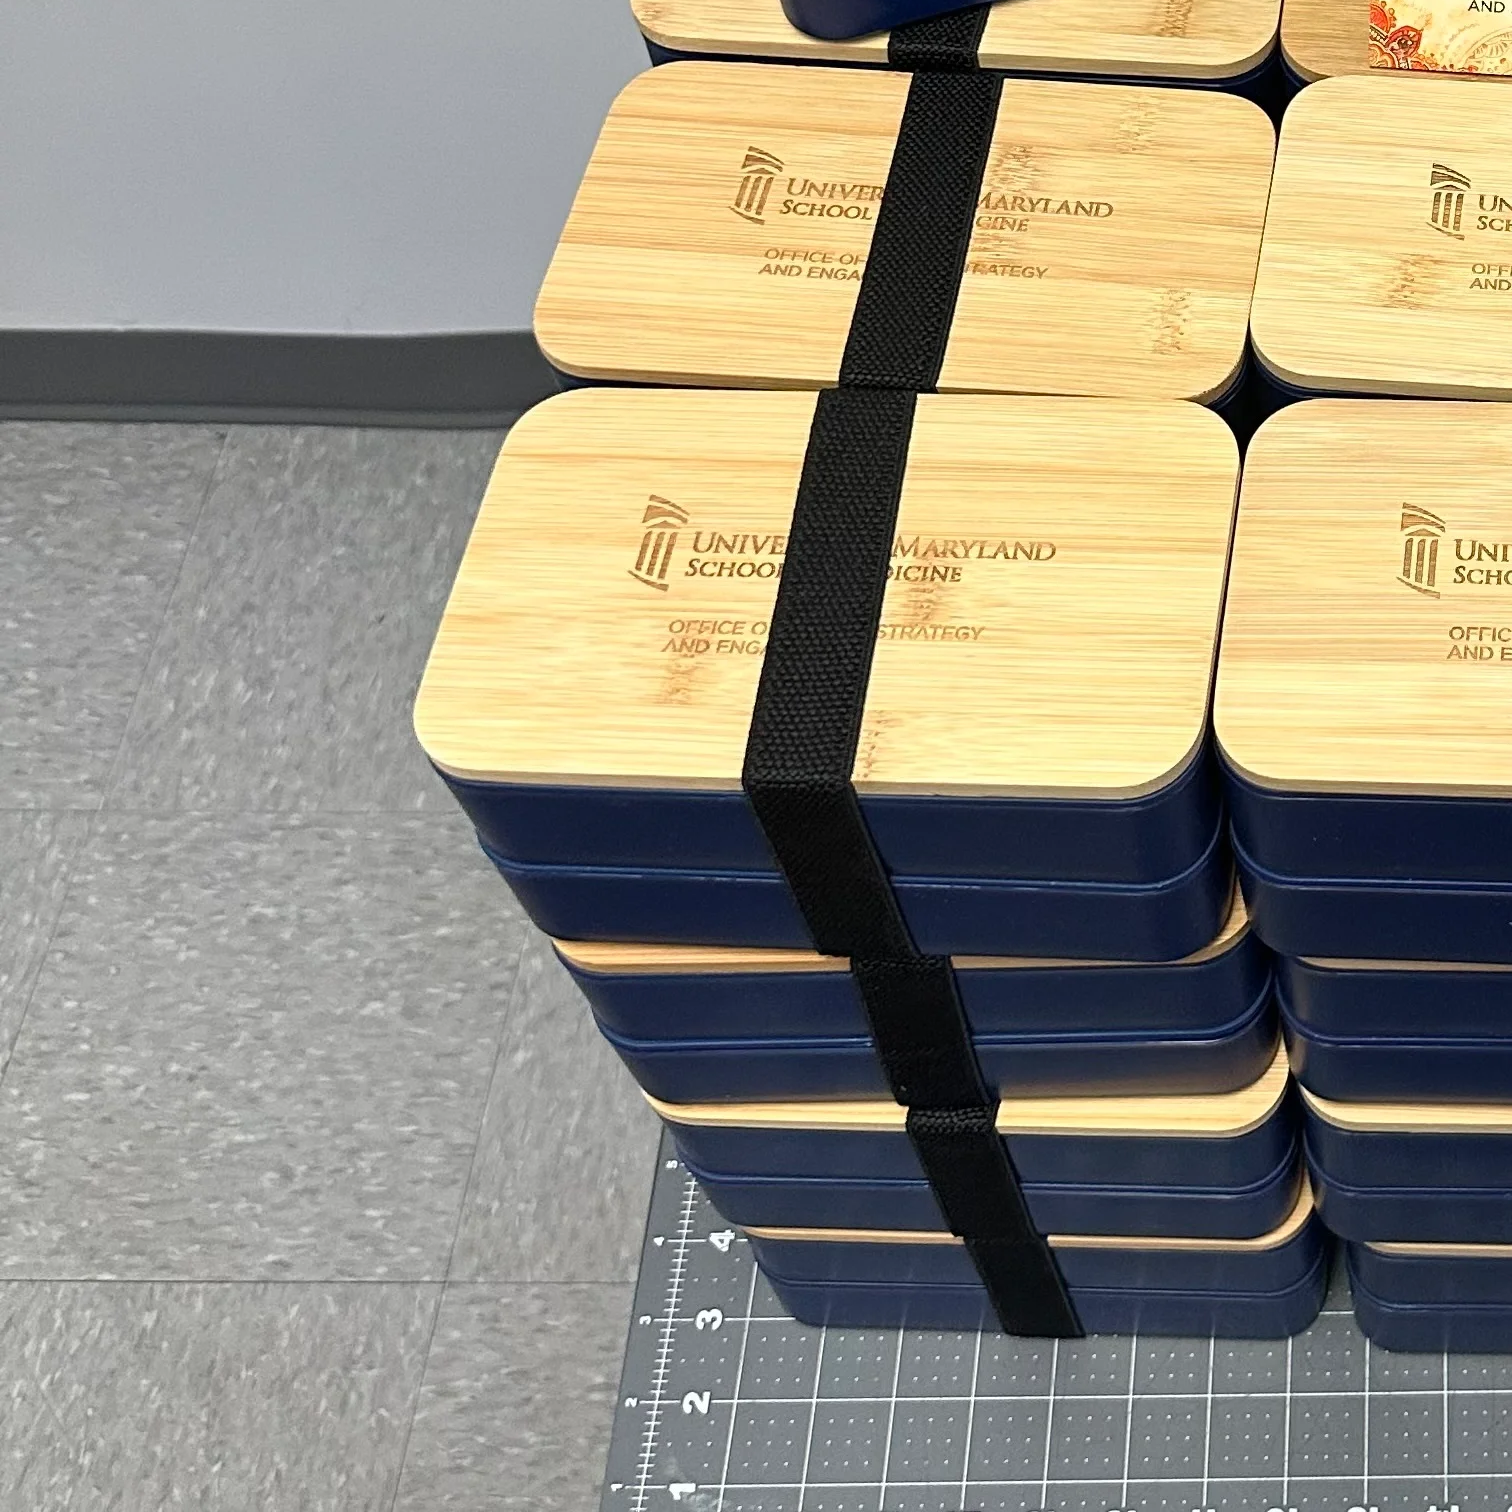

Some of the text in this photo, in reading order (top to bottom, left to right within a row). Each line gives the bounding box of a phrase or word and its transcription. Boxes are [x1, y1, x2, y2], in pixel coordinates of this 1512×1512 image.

[1467, 0, 1505, 14] AND
[786, 177, 884, 202] UNIVER
[780, 199, 1030, 233] SCHOOL CINE
[764, 248, 834, 263] OFFICE
[758, 263, 803, 277] AND
[1469, 277, 1512, 291] AND
[692, 531, 1057, 561] UNIVE MARYLAND
[668, 619, 986, 641] OFFICE O STRATEGY
[660, 637, 711, 654] AND
[1446, 644, 1494, 661] AND
[653, 1235, 666, 1247] 4
[709, 1228, 737, 1253] 4
[639, 1314, 653, 1326] 3
[696, 1307, 724, 1332] 3
[624, 1396, 639, 1408] 2
[682, 1390, 711, 1415] 2
[668, 1481, 697, 1500] 1
